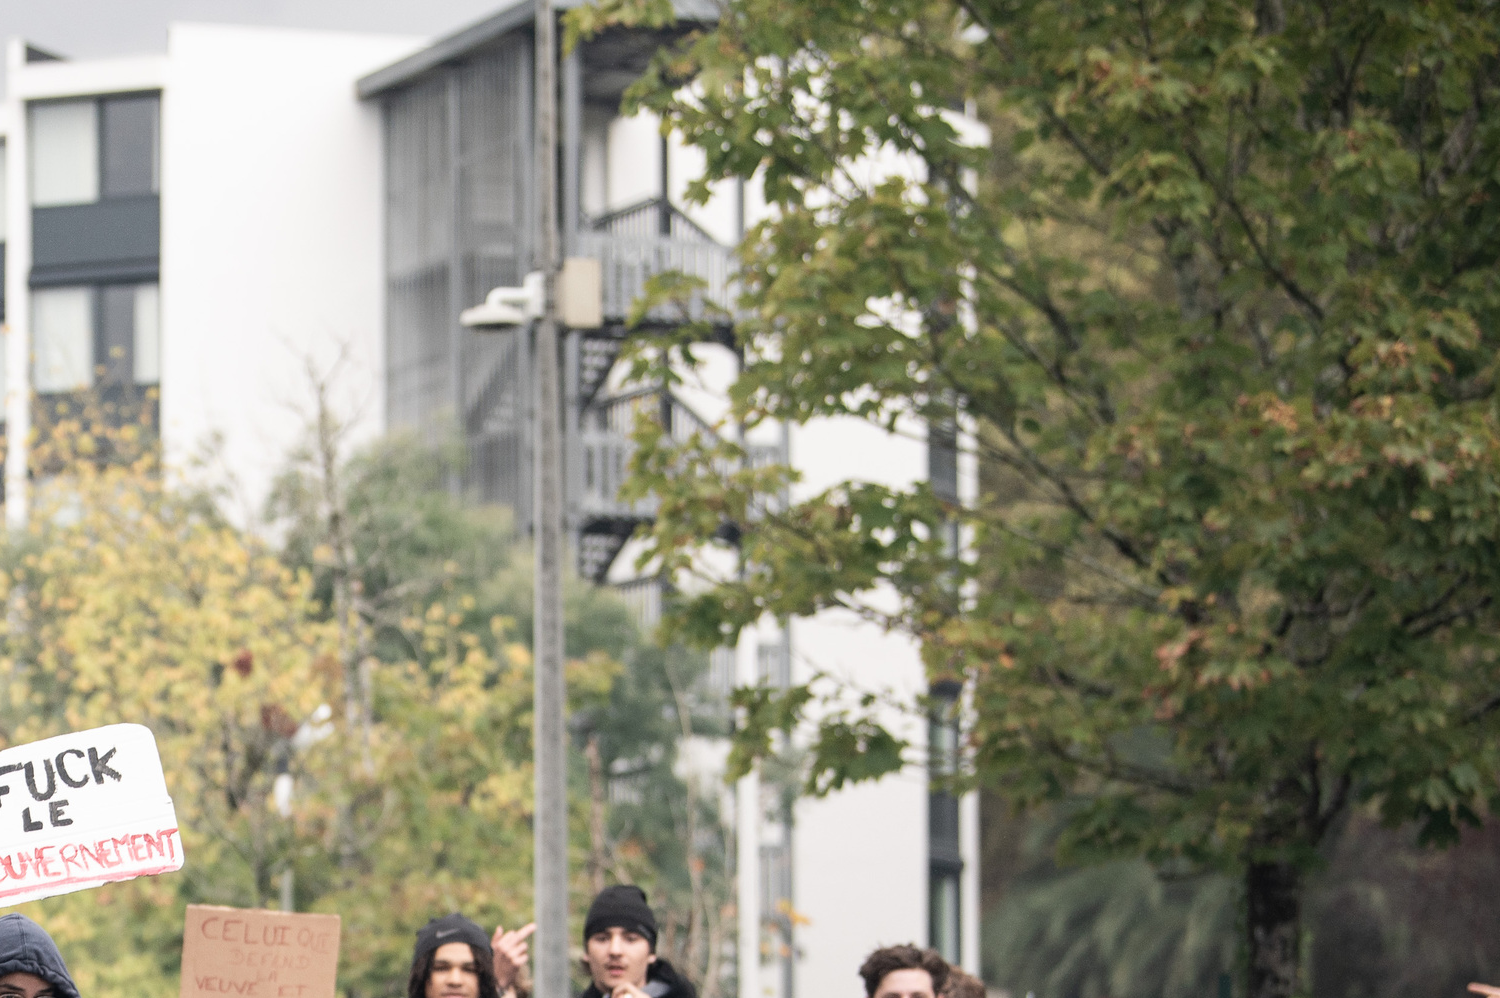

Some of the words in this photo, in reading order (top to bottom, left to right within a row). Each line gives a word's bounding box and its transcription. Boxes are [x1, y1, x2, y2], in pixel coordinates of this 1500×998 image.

[22, 799, 74, 833] LE
[201, 916, 292, 947] CELUI
[195, 975, 258, 996] VEUVE
[277, 984, 308, 998] ET
